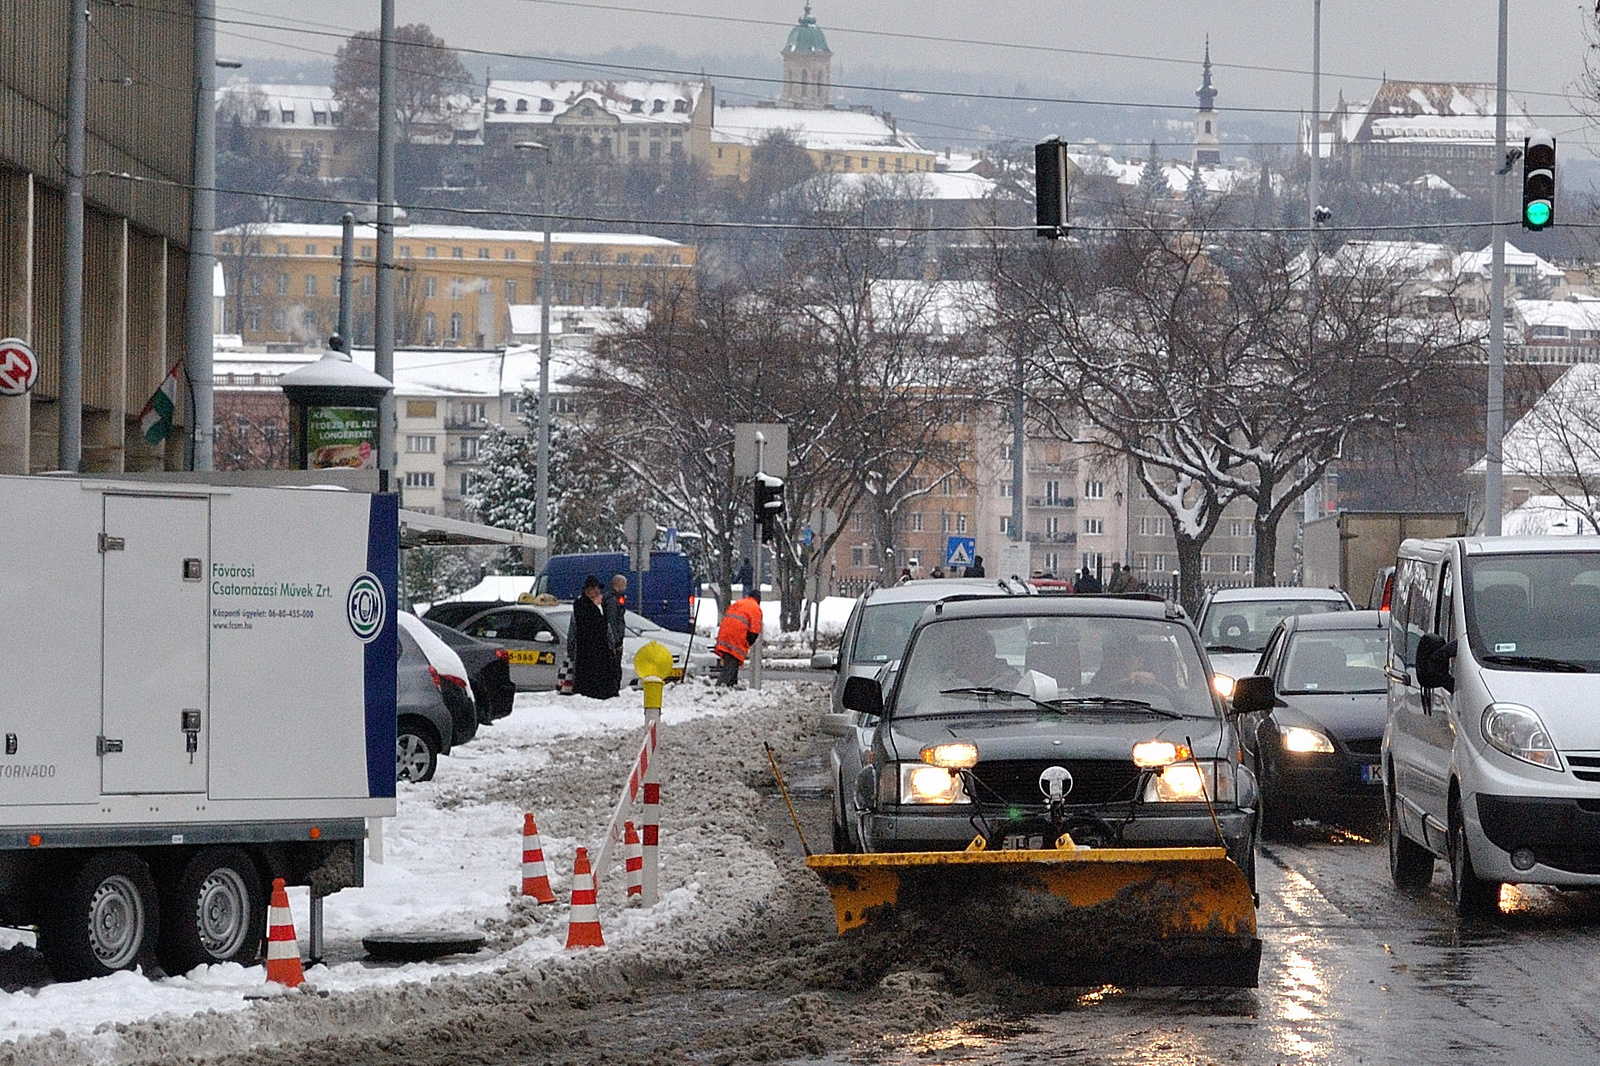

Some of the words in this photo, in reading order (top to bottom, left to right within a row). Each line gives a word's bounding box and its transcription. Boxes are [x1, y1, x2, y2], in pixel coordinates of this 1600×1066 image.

[212, 563, 255, 578] Fővárosi
[212, 581, 277, 597] Csatornázási
[280, 582, 313, 598] Művek
[316, 584, 333, 598] Zrt.
[212, 608, 241, 619] Központi
[213, 621, 253, 630] www.fcsm.hu
